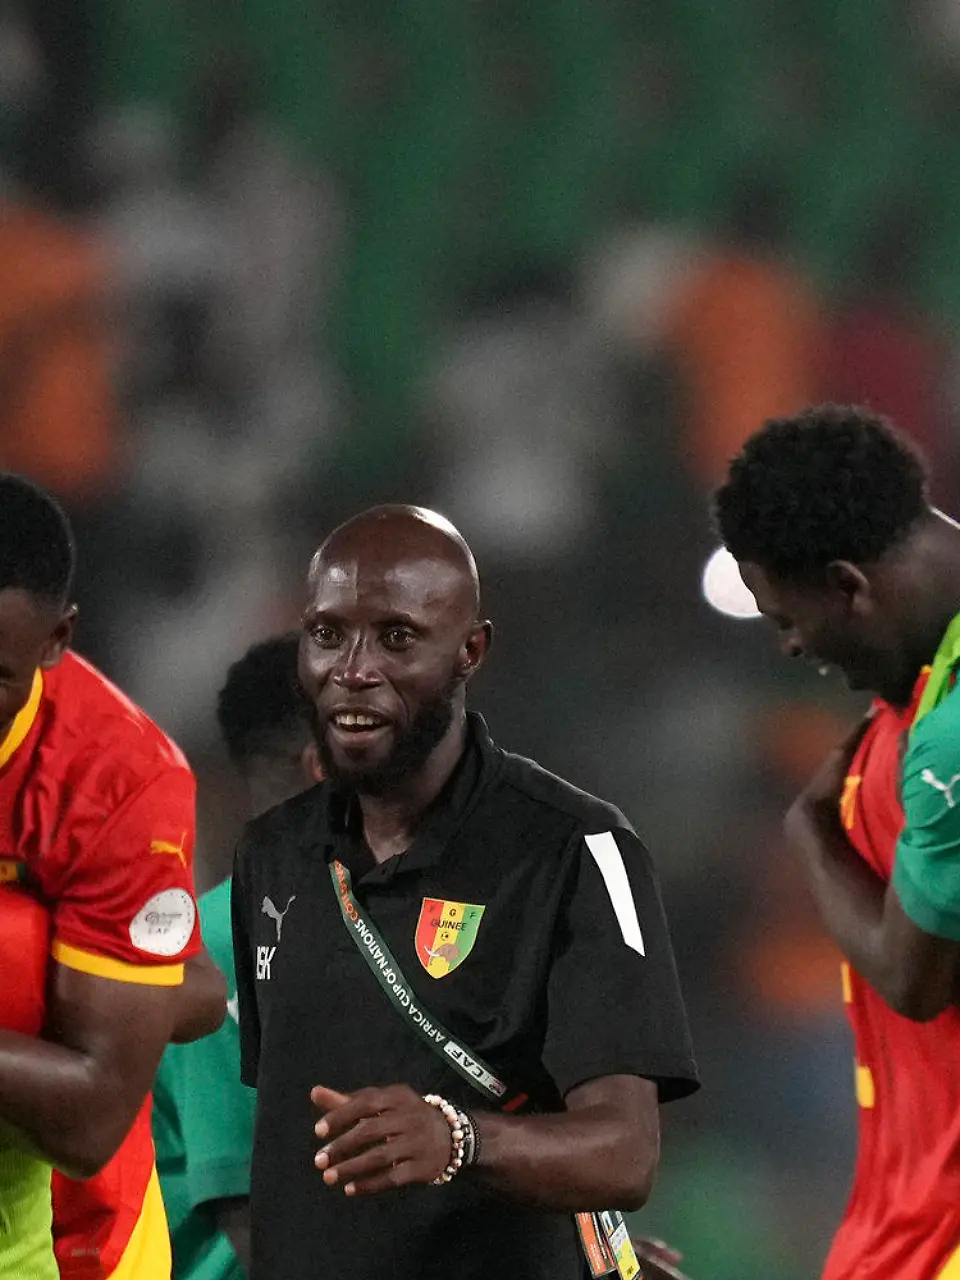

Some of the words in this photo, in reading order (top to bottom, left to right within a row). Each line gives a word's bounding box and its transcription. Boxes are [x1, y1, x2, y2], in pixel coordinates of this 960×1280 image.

[354, 918, 388, 970] NATIONS
[382, 968, 397, 984] OF
[393, 984, 410, 1007] CUP
[409, 1004, 446, 1043] AFRICA
[449, 1049, 484, 1079] CAF
